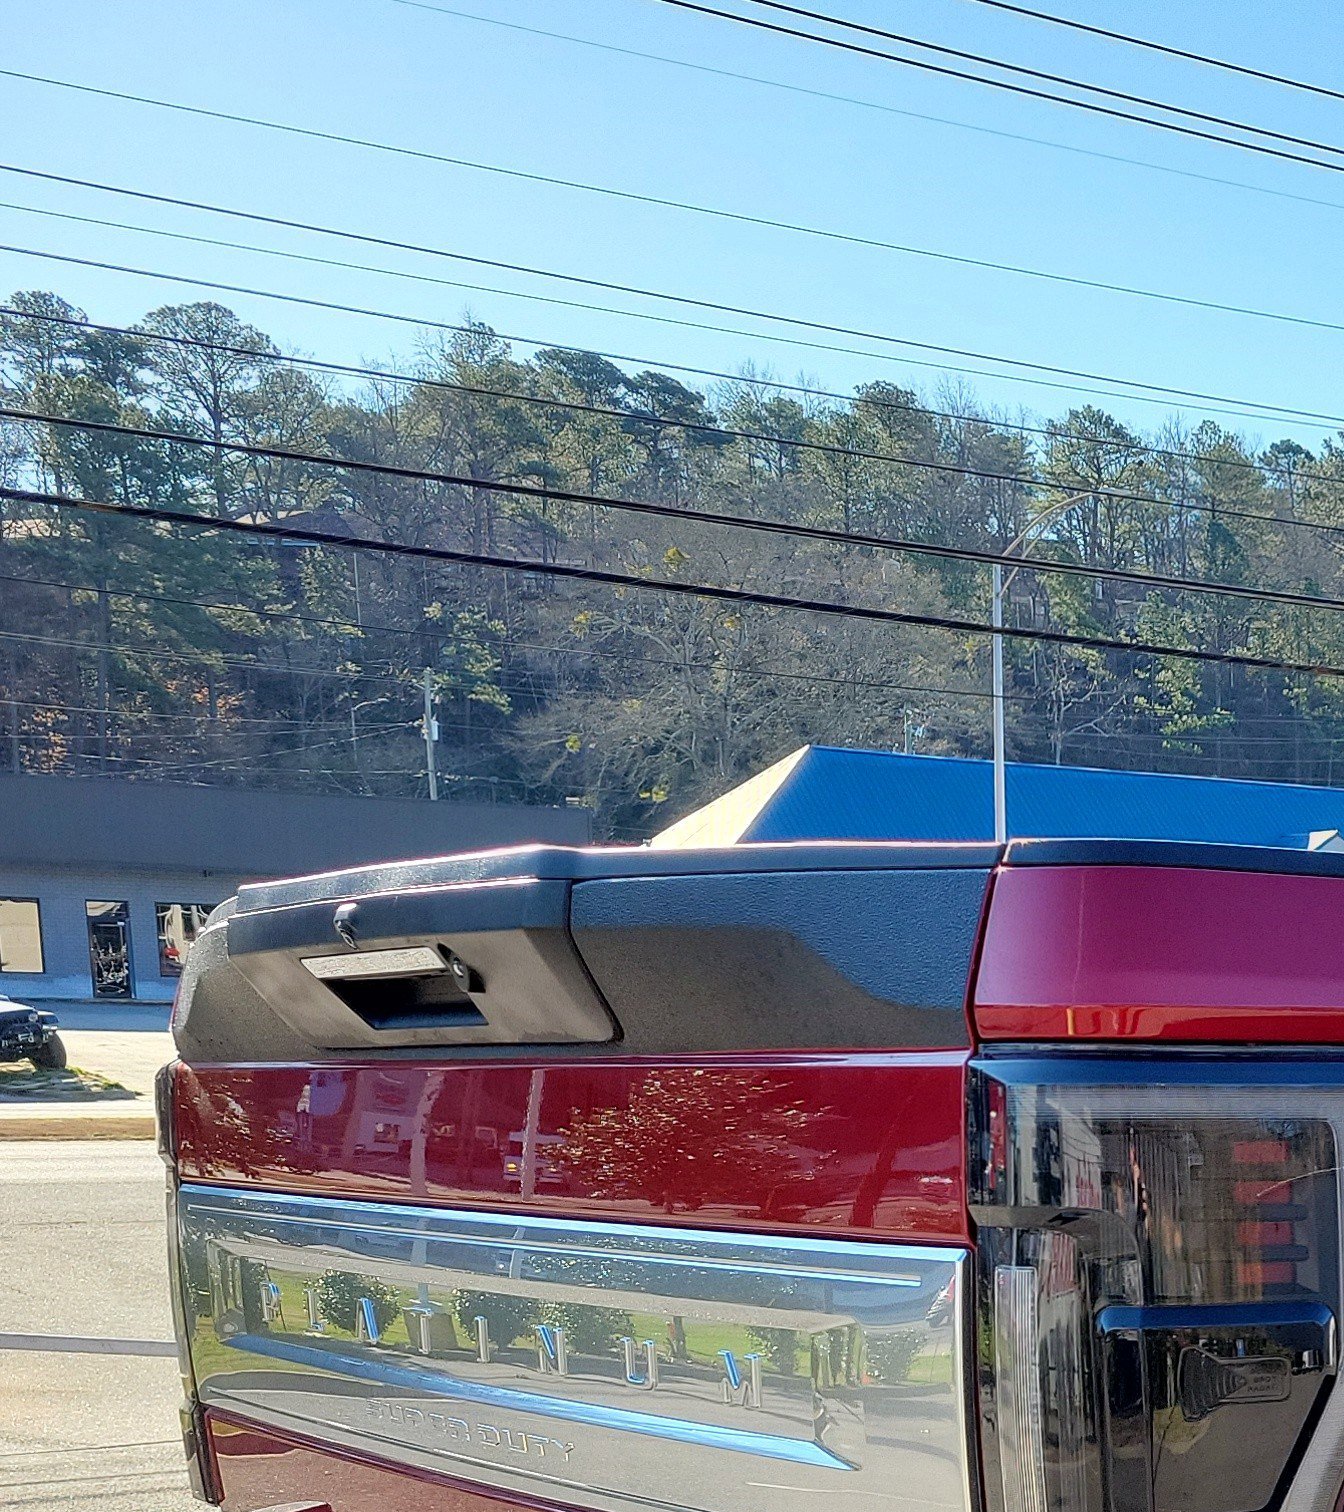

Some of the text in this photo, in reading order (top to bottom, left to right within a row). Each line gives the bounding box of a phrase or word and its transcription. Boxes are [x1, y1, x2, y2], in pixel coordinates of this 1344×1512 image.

[259, 1279, 764, 1408] PLATINUM
[366, 1399, 576, 1463] SUPER DUTY
